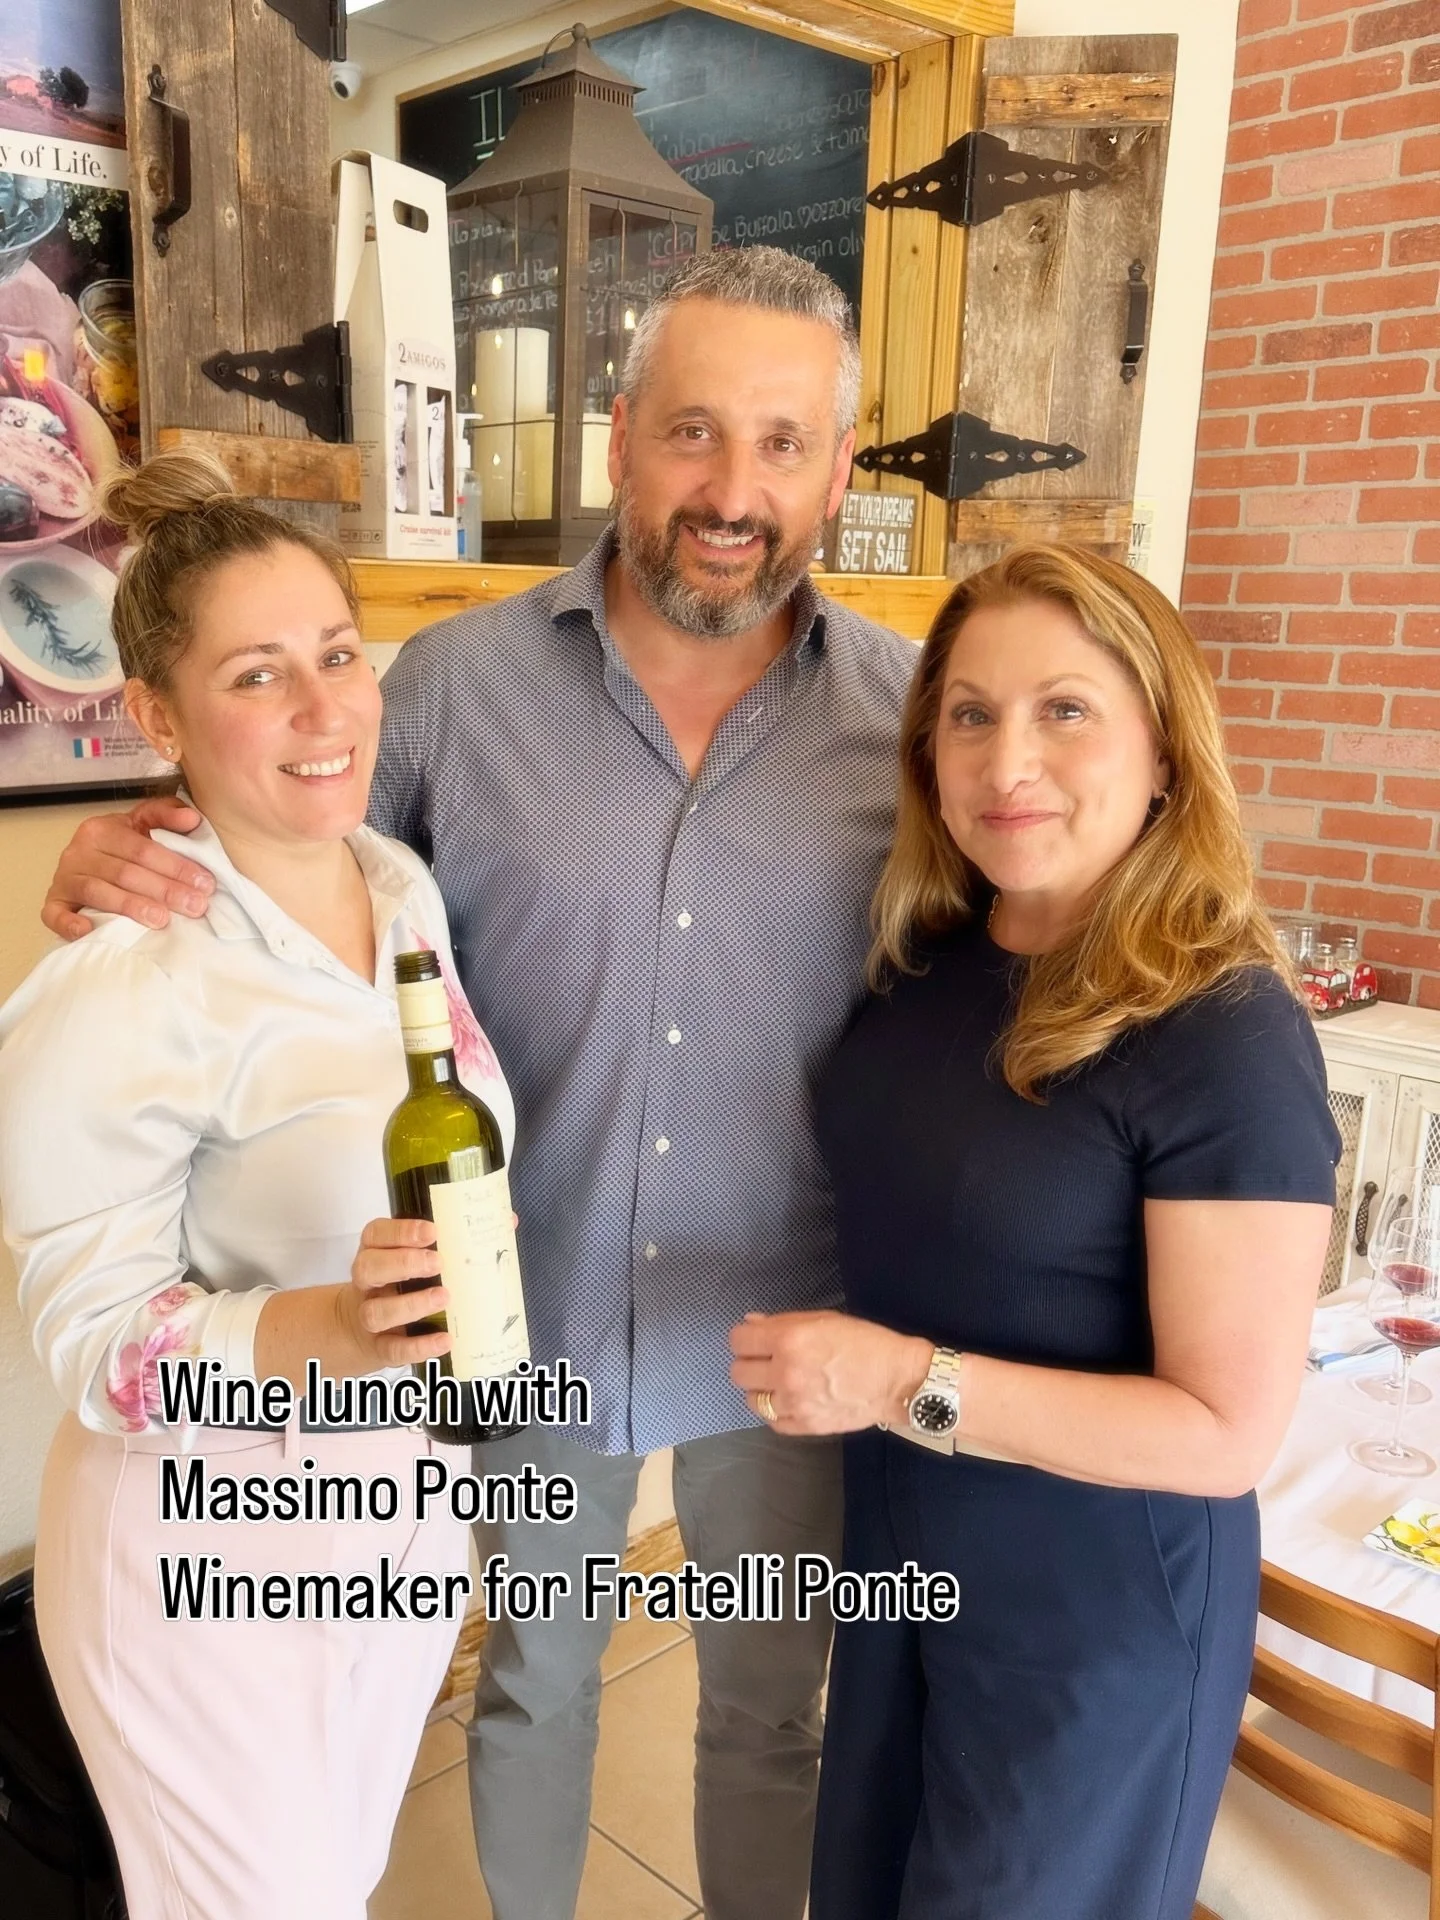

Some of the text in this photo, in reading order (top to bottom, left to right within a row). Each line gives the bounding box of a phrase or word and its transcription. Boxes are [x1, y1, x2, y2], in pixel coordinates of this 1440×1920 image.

[20, 144, 45, 168] of
[52, 147, 107, 179] Life.
[735, 208, 794, 240] Buffala
[842, 493, 915, 529] LET YOUR DREAMS
[839, 529, 910, 574] SET SAIL
[63, 700, 87, 722] of
